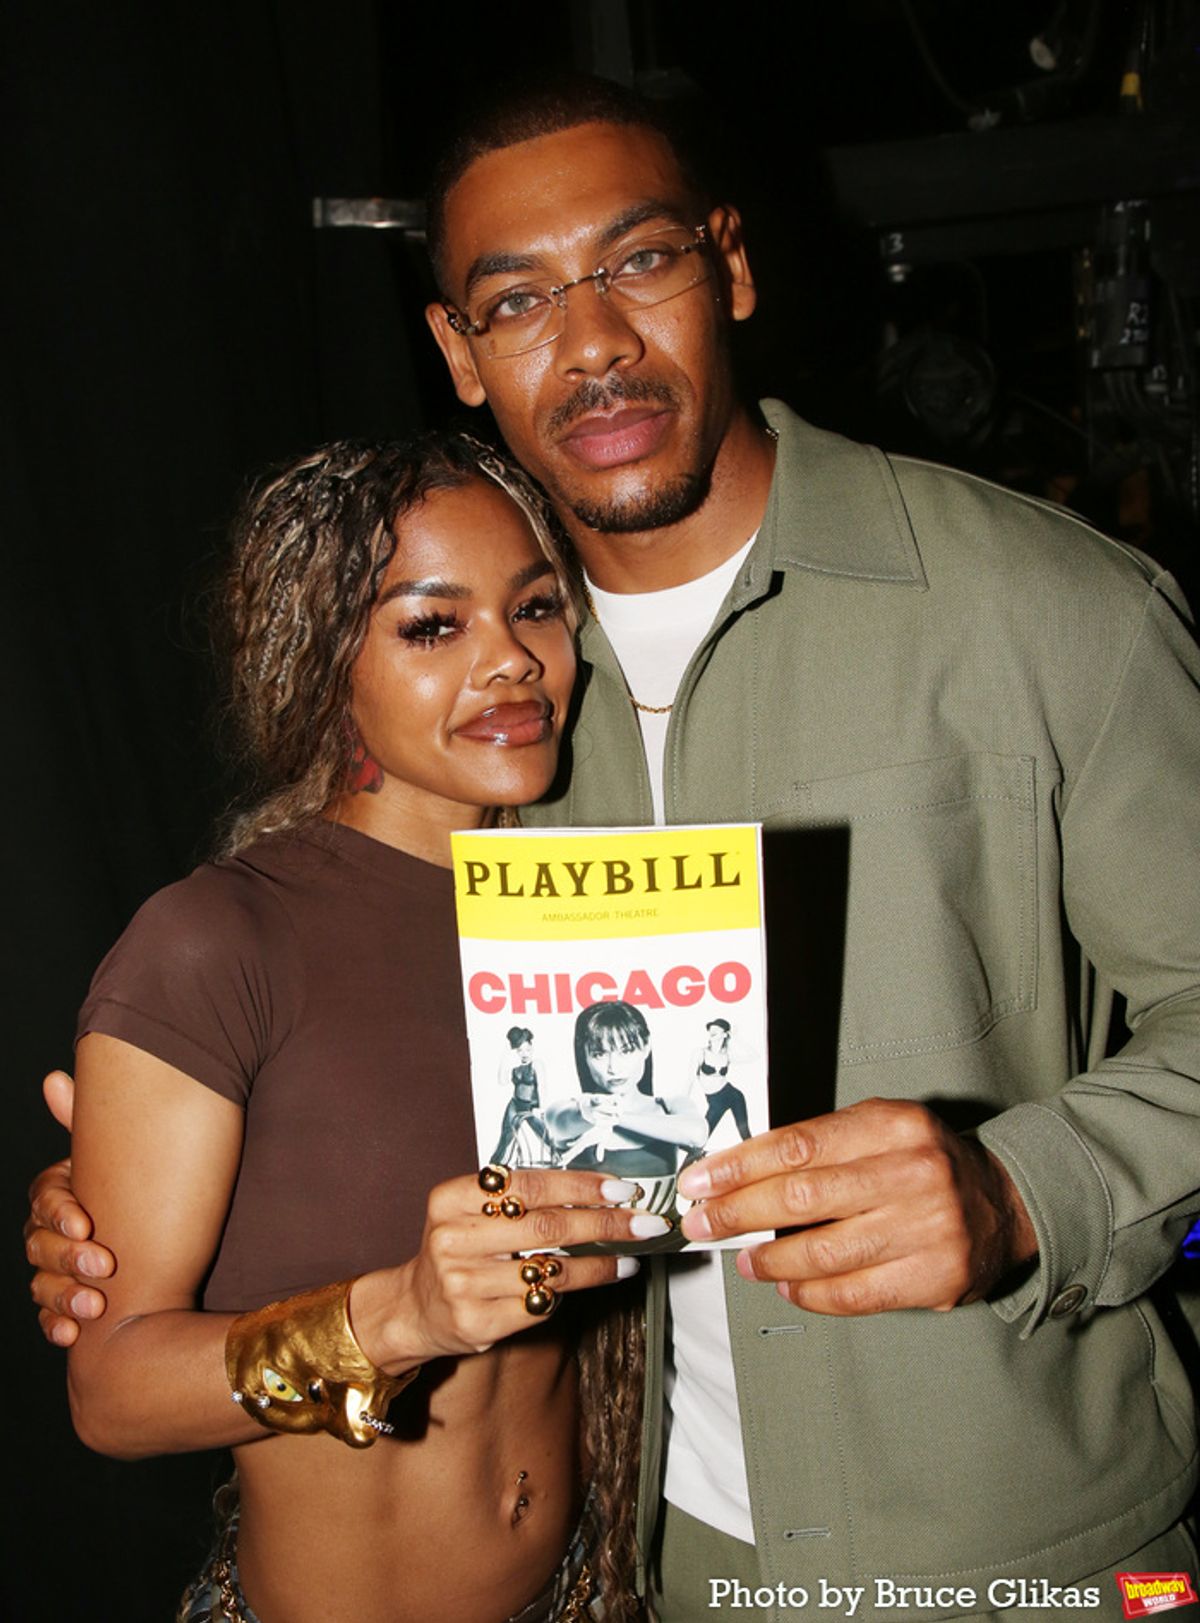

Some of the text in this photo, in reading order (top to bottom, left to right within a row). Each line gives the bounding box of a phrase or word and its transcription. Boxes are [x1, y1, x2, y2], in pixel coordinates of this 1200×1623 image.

[463, 852, 741, 898] PLAYBILL
[541, 908, 659, 922] AMBASSADOR THEATRE
[468, 961, 752, 1015] CHICAGO
